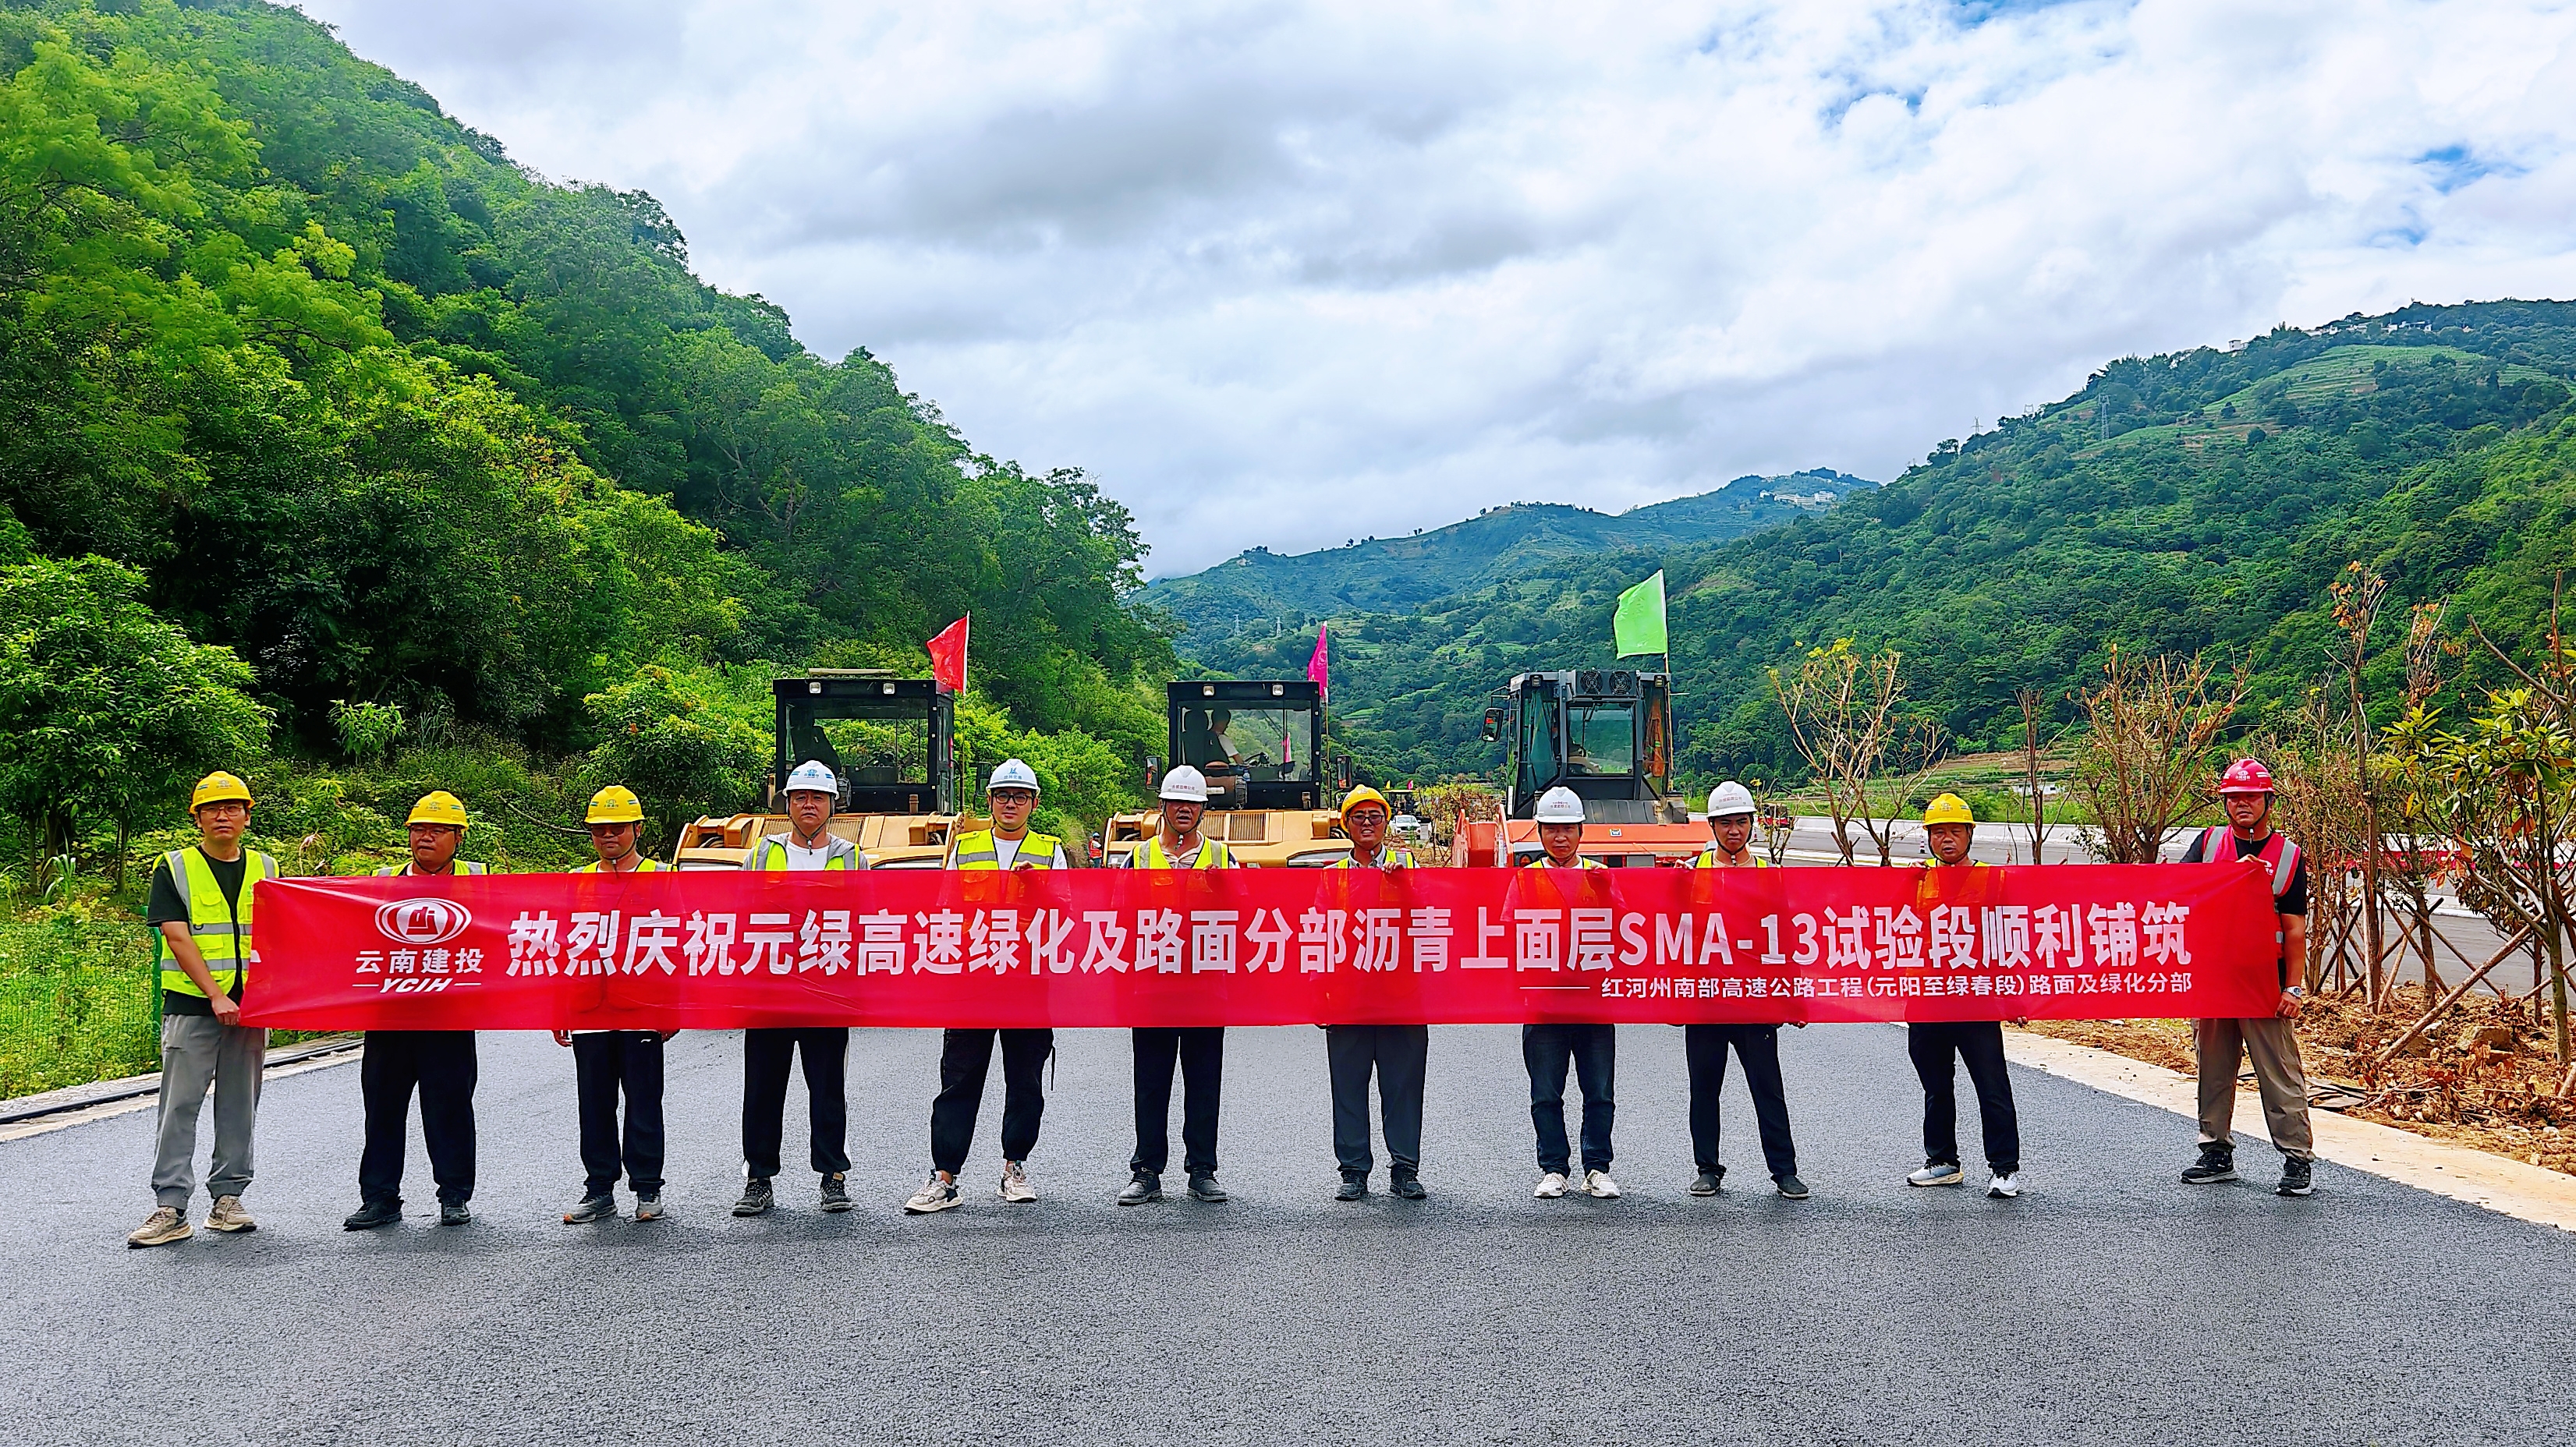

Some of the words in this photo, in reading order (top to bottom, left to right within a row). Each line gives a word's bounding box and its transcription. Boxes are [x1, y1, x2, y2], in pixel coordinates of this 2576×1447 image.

[506, 900, 2192, 977] 热烈庆祝元绿高速绿化及路面分部沥青上面层SMA-13试验段顺利铺筑
[356, 948, 484, 974] 云南建投
[380, 978, 453, 993] YCIH
